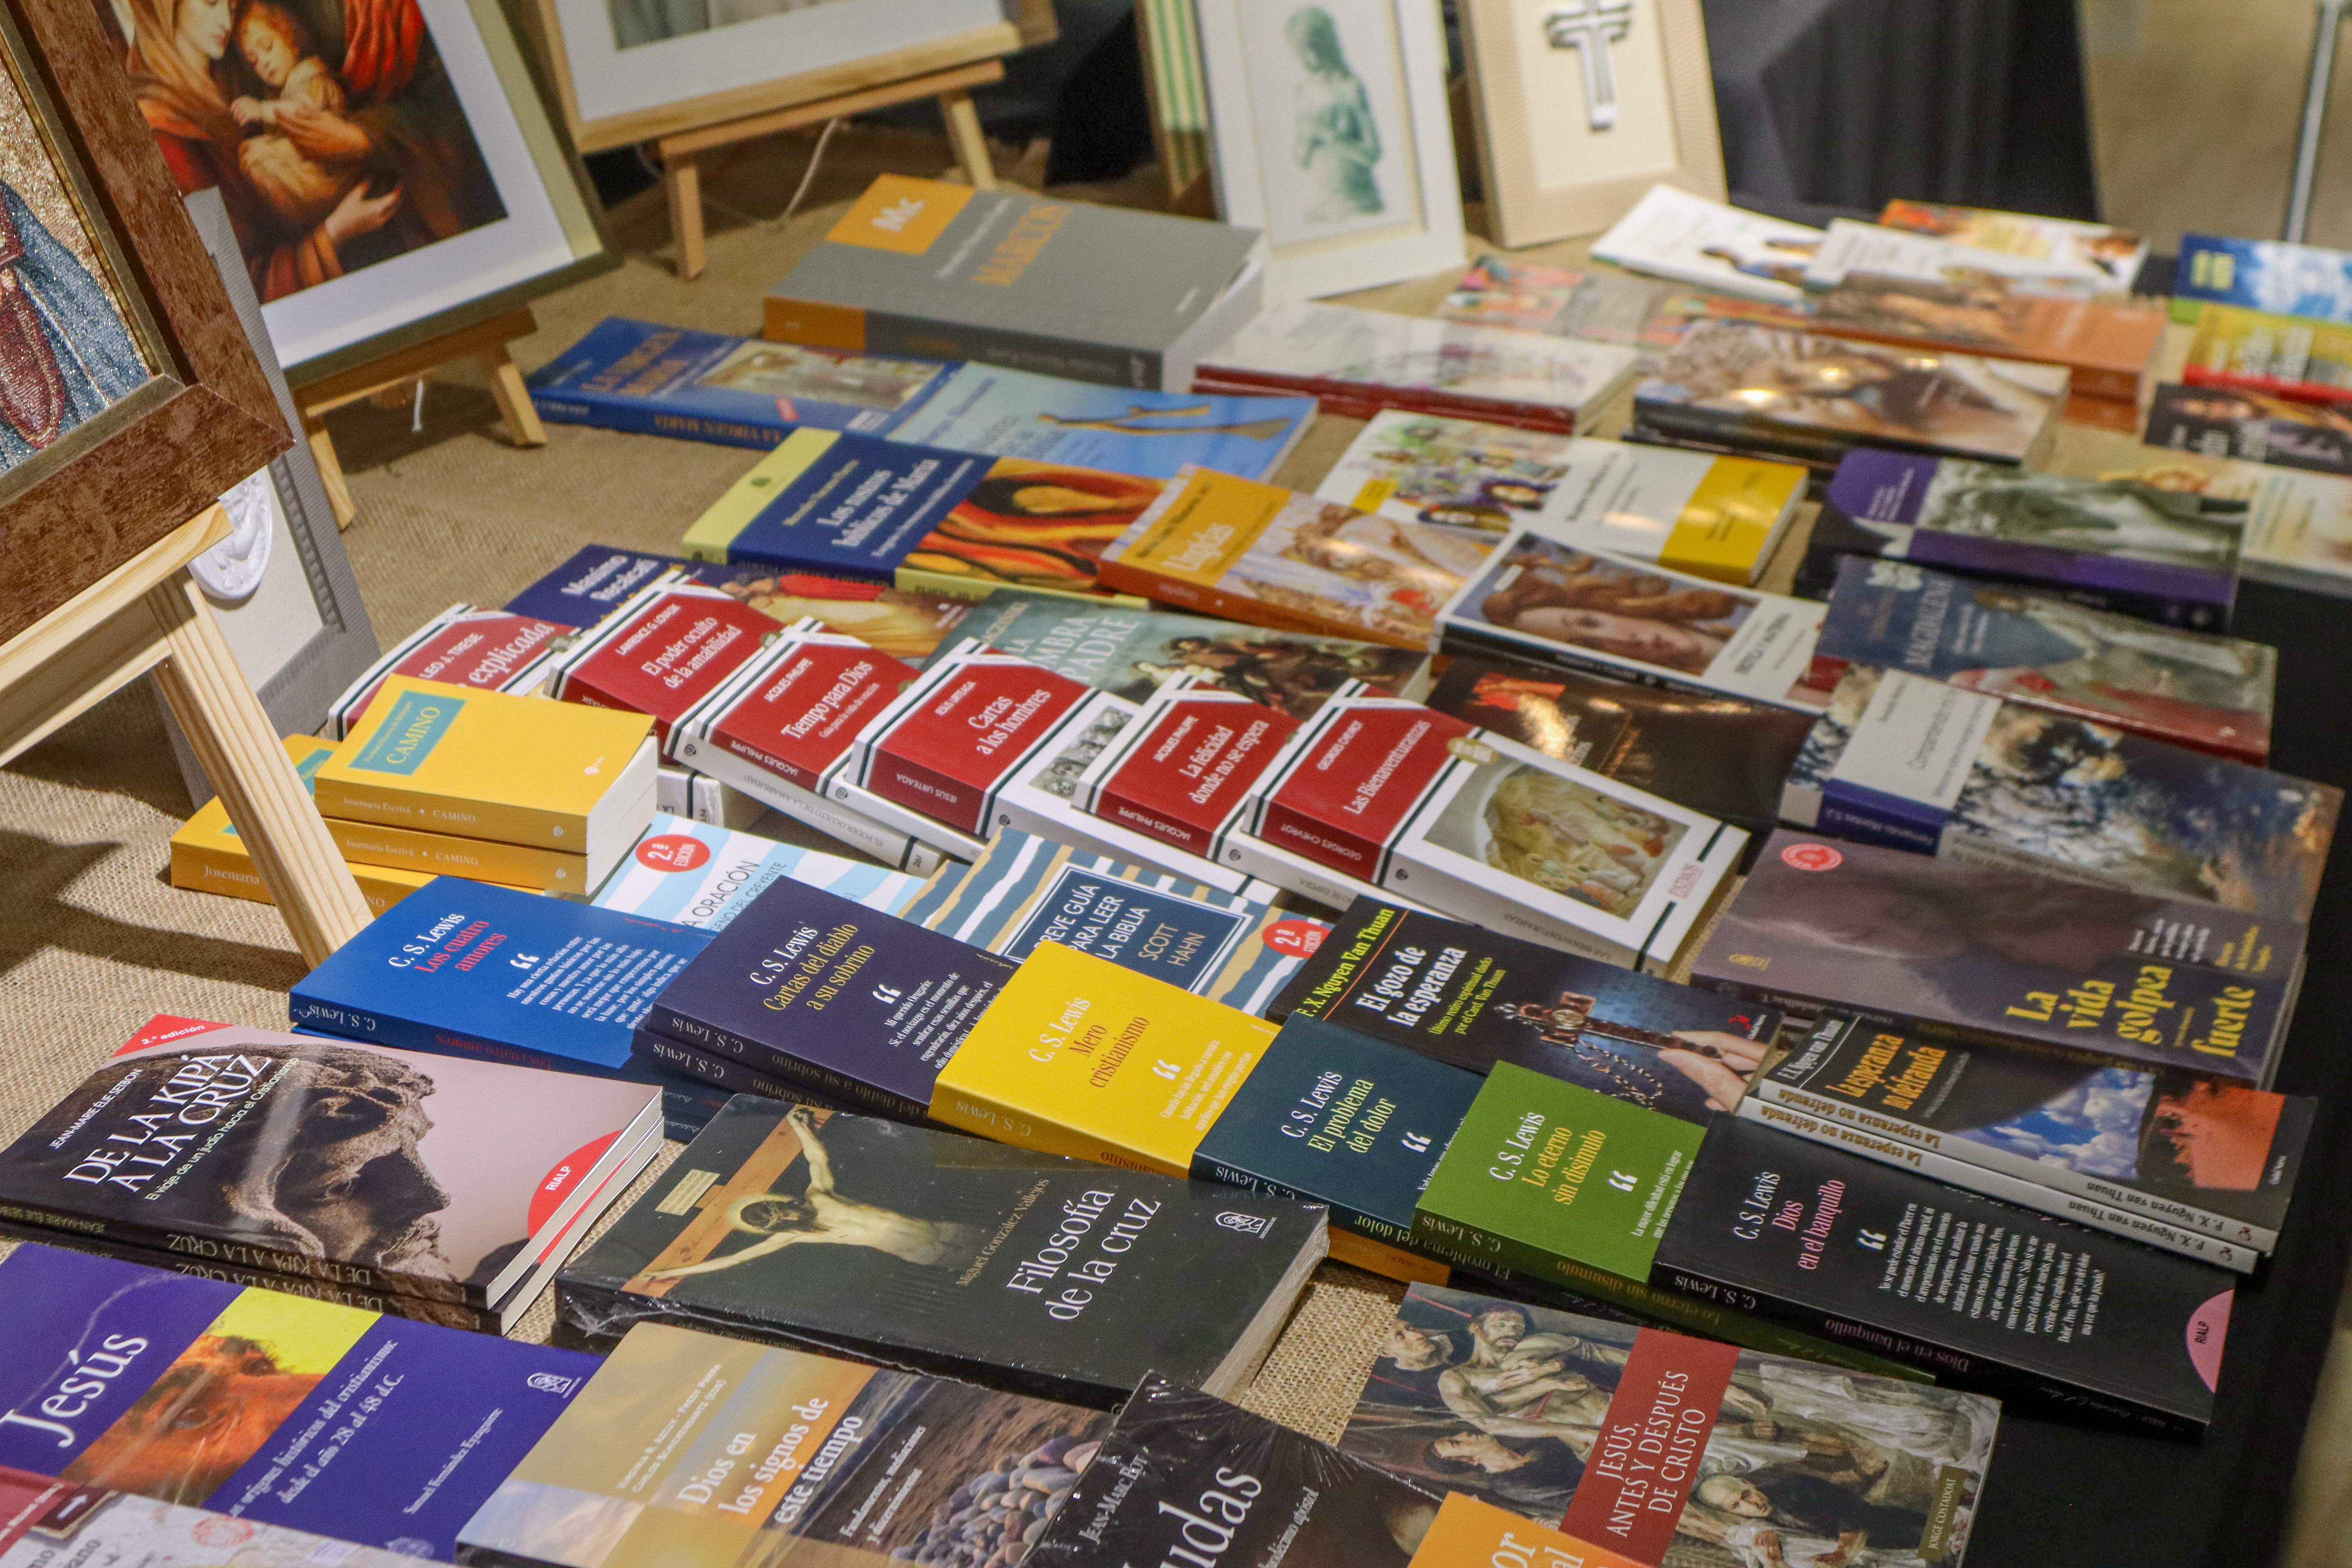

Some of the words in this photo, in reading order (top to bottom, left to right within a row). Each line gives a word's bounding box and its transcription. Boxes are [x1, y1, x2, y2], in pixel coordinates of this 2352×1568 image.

[468, 623, 555, 684] explicada
[641, 662, 660, 675] El
[655, 641, 687, 667] poder
[682, 617, 719, 645] oculto
[663, 675, 681, 689] de
[677, 665, 692, 678] la
[688, 624, 742, 670] amabilidad
[1005, 639, 1034, 653] LA
[781, 703, 830, 739] Tiempo
[822, 683, 851, 709] para
[839, 661, 873, 686] Dios
[968, 696, 1013, 728] Cartas
[995, 689, 1051, 733] hombres
[387, 707, 441, 764] CAMINO
[976, 745, 994, 755] a
[978, 730, 1009, 748] los
[1189, 725, 1234, 766] felicidad
[1179, 764, 1203, 778] La
[1189, 773, 1225, 804] donde
[1215, 760, 1235, 776] no
[1227, 749, 1245, 763] se
[1236, 720, 1270, 751] espera
[1343, 795, 1370, 814] Las
[1357, 720, 1432, 797] Bienaventuranzas
[434, 810, 476, 823] CAMINO
[673, 844, 696, 867] EDICIÓN
[913, 855, 922, 867] 261
[692, 860, 760, 918] ORACIÓN
[1034, 915, 1076, 948] REVE
[1063, 885, 1100, 915] GUÍA
[1089, 896, 1125, 924] LEER
[1108, 907, 1150, 942] BIBLIA
[1356, 908, 1396, 941] Thuan
[416, 913, 465, 943] Lewis
[775, 926, 818, 960] Lewis
[1138, 923, 1178, 961] SCOTT
[388, 956, 415, 967] C.
[403, 944, 430, 955] S.
[414, 953, 450, 973] Los
[443, 921, 490, 952] cuatro
[455, 933, 507, 971] amores
[1095, 944, 1123, 959] LA
[1167, 932, 1206, 967] HAHN
[1341, 941, 1372, 961] Van
[750, 972, 776, 985] C.
[762, 959, 788, 972] S.
[763, 973, 811, 1011] Cartas
[799, 953, 828, 975] del
[816, 924, 858, 956] diablo
[829, 945, 875, 987] sobrino
[1313, 961, 1356, 999] Nguyen
[1356, 993, 1392, 1012] El
[1376, 964, 1414, 999] gozo
[1395, 946, 1427, 965] de
[815, 986, 840, 1002] su
[1303, 997, 1327, 1009] X.
[1387, 1011, 1421, 1027] la
[1405, 947, 1468, 1012] esperanza
[806, 1000, 825, 1011] a
[884, 1018, 897, 1027] Mi
[893, 1002, 913, 1020] querido
[1049, 997, 1092, 1035] Lewis
[1296, 1007, 1317, 1017] F.
[2005, 990, 2060, 1022] La
[2059, 979, 2116, 1029] vida
[2116, 965, 2176, 1045] golpea
[160, 1024, 205, 1040] edición
[2191, 985, 2256, 1057] fuerte
[1029, 1049, 1055, 1063] C.
[1039, 1033, 1065, 1048] S.
[1069, 1024, 1107, 1057] Mero
[1089, 1016, 1150, 1089] cristianismo
[1845, 1034, 1905, 1088] esperanza
[178, 1054, 273, 1125] CRUZ
[250, 1058, 299, 1100] Cristianismo
[1301, 1071, 1343, 1110] Lewis
[49, 1106, 101, 1149] JEAN-MARIE
[93, 1094, 116, 1109] ÉLIE
[109, 1068, 144, 1097] SETBON
[244, 1100, 257, 1109] el
[1292, 1110, 1318, 1124] S.
[1308, 1134, 1336, 1154] El
[1323, 1078, 1375, 1140] problema
[1360, 1098, 1397, 1134] dolor
[1882, 1095, 1914, 1110] no
[63, 1148, 131, 1185] DE
[107, 1112, 175, 1145] LA
[149, 1054, 235, 1105] KIPÁ
[217, 1110, 247, 1132] hacia
[1281, 1124, 1308, 1138] C.
[1506, 1112, 1545, 1150] Lewis
[129, 1133, 198, 1167] LA
[188, 1149, 205, 1163] un
[200, 1132, 223, 1153] judío
[1346, 1130, 1375, 1154] del
[1499, 1151, 1525, 1166] S.
[1521, 1169, 1550, 1188] Lo
[1537, 1127, 1572, 1169] eterno
[1561, 1129, 1606, 1186] disimulo
[107, 1173, 156, 1193] A
[156, 1176, 181, 1192] viaje
[176, 1163, 193, 1175] de
[544, 1165, 572, 1191] RIALP
[1490, 1167, 1517, 1181] C.
[144, 1192, 161, 1201] El
[1551, 1188, 1579, 1205] sin
[1744, 1171, 1782, 1211] Lewis
[1101, 1198, 1161, 1253] cruz
[1740, 1210, 1767, 1226] S.
[1772, 1200, 1804, 1232] Dios
[1812, 1180, 1846, 1239] banquillo
[956, 1256, 989, 1286] Miguel
[982, 1213, 1022, 1255] González
[1014, 1178, 1049, 1213] Vallejos
[1006, 1190, 1115, 1294] Filosofía
[1733, 1226, 1760, 1241] C.
[1801, 1236, 1824, 1253] el
[1067, 1260, 1118, 1284] la
[1798, 1257, 1820, 1270] en
[1045, 1288, 1093, 1320] de
[2195, 1321, 2209, 1344] RIALP
[0, 1334, 148, 1448] Jesús
[1638, 1370, 1688, 1454] DESPUÉS
[718, 1485, 764, 1515] los
[749, 1423, 809, 1483] signos
[791, 1397, 829, 1421] de
[1596, 1423, 1641, 1481] JESÚS,
[1661, 1409, 1706, 1481] CRISTO
[677, 1458, 735, 1505] Dios
[726, 1432, 757, 1456] en
[774, 1484, 813, 1524] este
[798, 1416, 863, 1482] tiempo
[1630, 1458, 1655, 1471] Y
[1606, 1477, 1648, 1537] ANTES
[1648, 1486, 1678, 1514] DE
[1122, 1466, 1262, 1568] udas
[1928, 1525, 1943, 1549] JORGE
